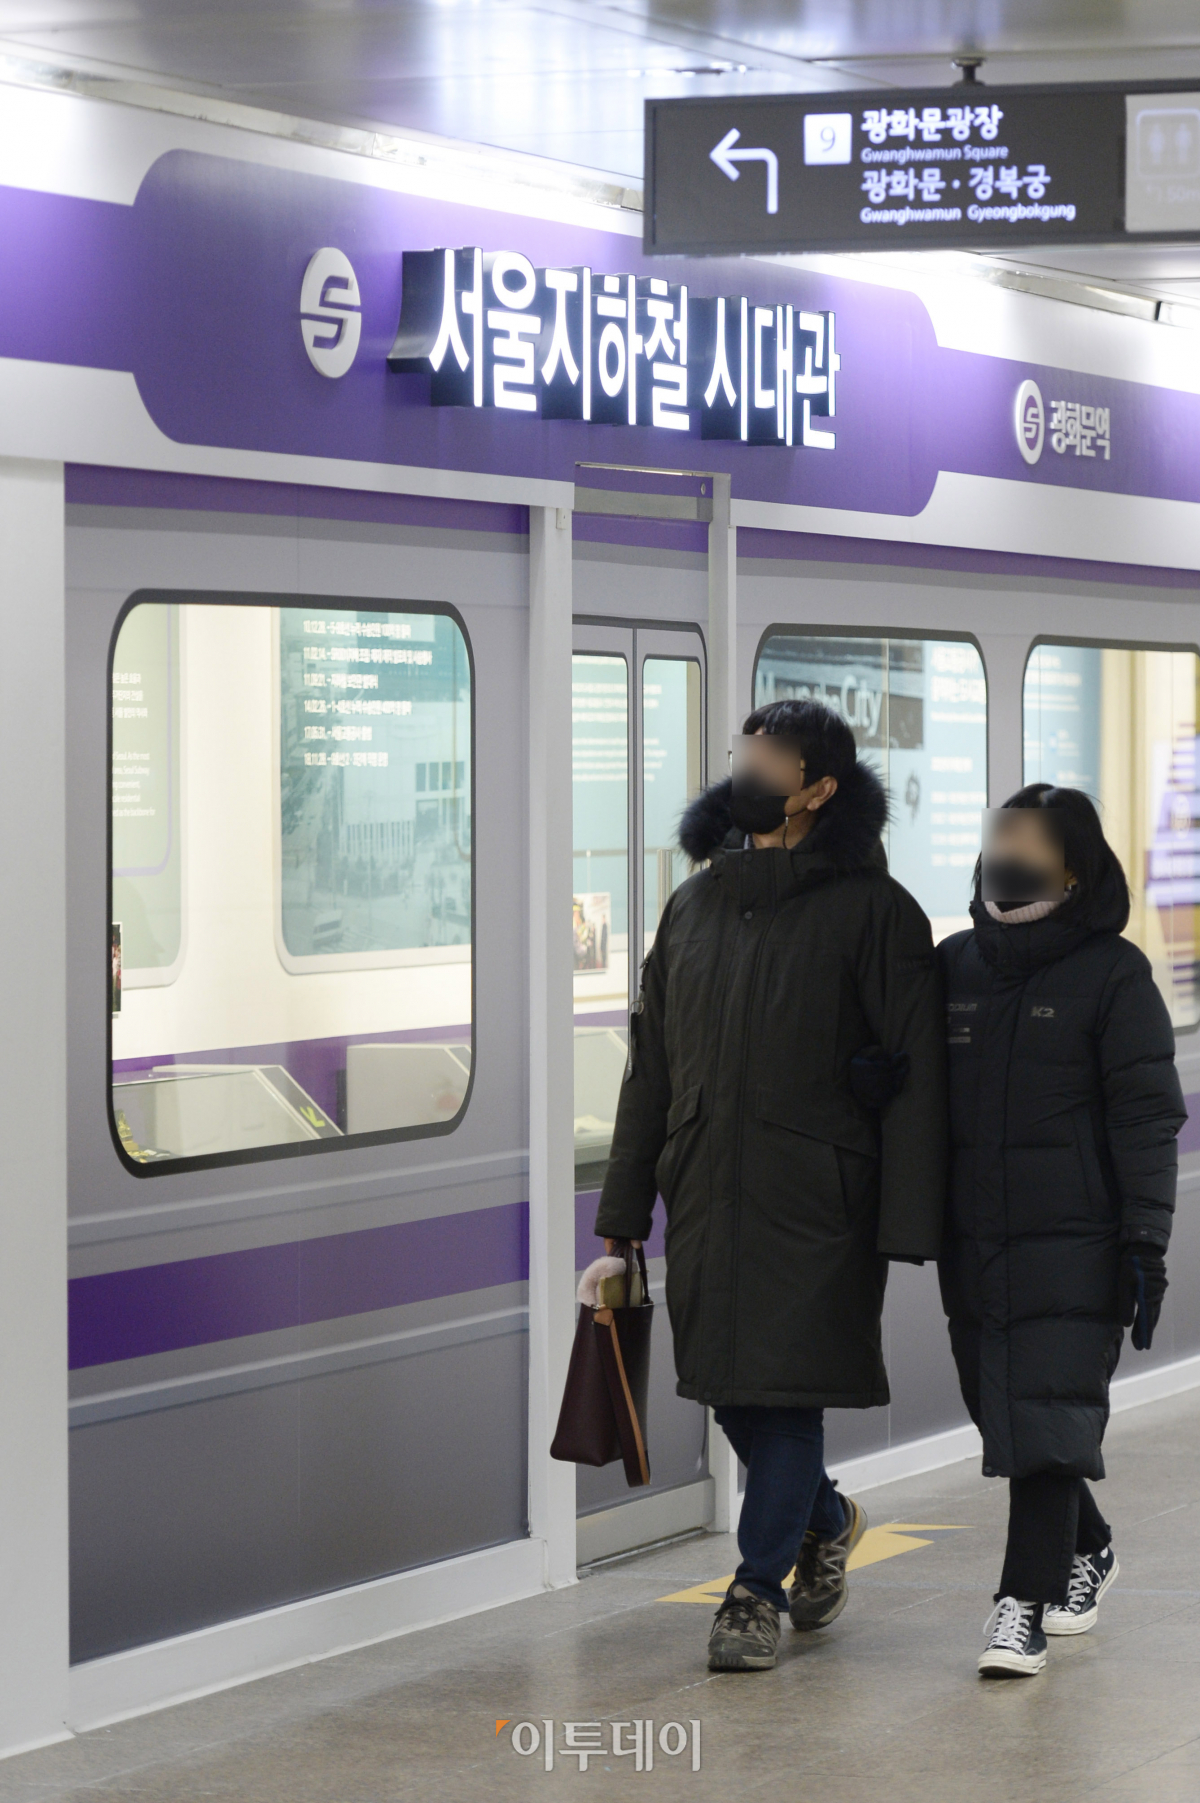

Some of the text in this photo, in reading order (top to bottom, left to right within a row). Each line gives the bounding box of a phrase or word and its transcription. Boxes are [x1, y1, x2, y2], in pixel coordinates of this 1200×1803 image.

[861, 105, 1004, 144] 광화문광장
[860, 144, 1009, 165] Gwanghwamun Square
[860, 167, 946, 204] 광화문
[969, 164, 1052, 200] 경복궁
[860, 203, 1077, 225] Gwanghwamun Gyeongbokgung
[428, 246, 842, 450] 서울지하철 시대관
[1049, 400, 1111, 461] 광화문역
[1030, 1006, 1055, 1018] K2
